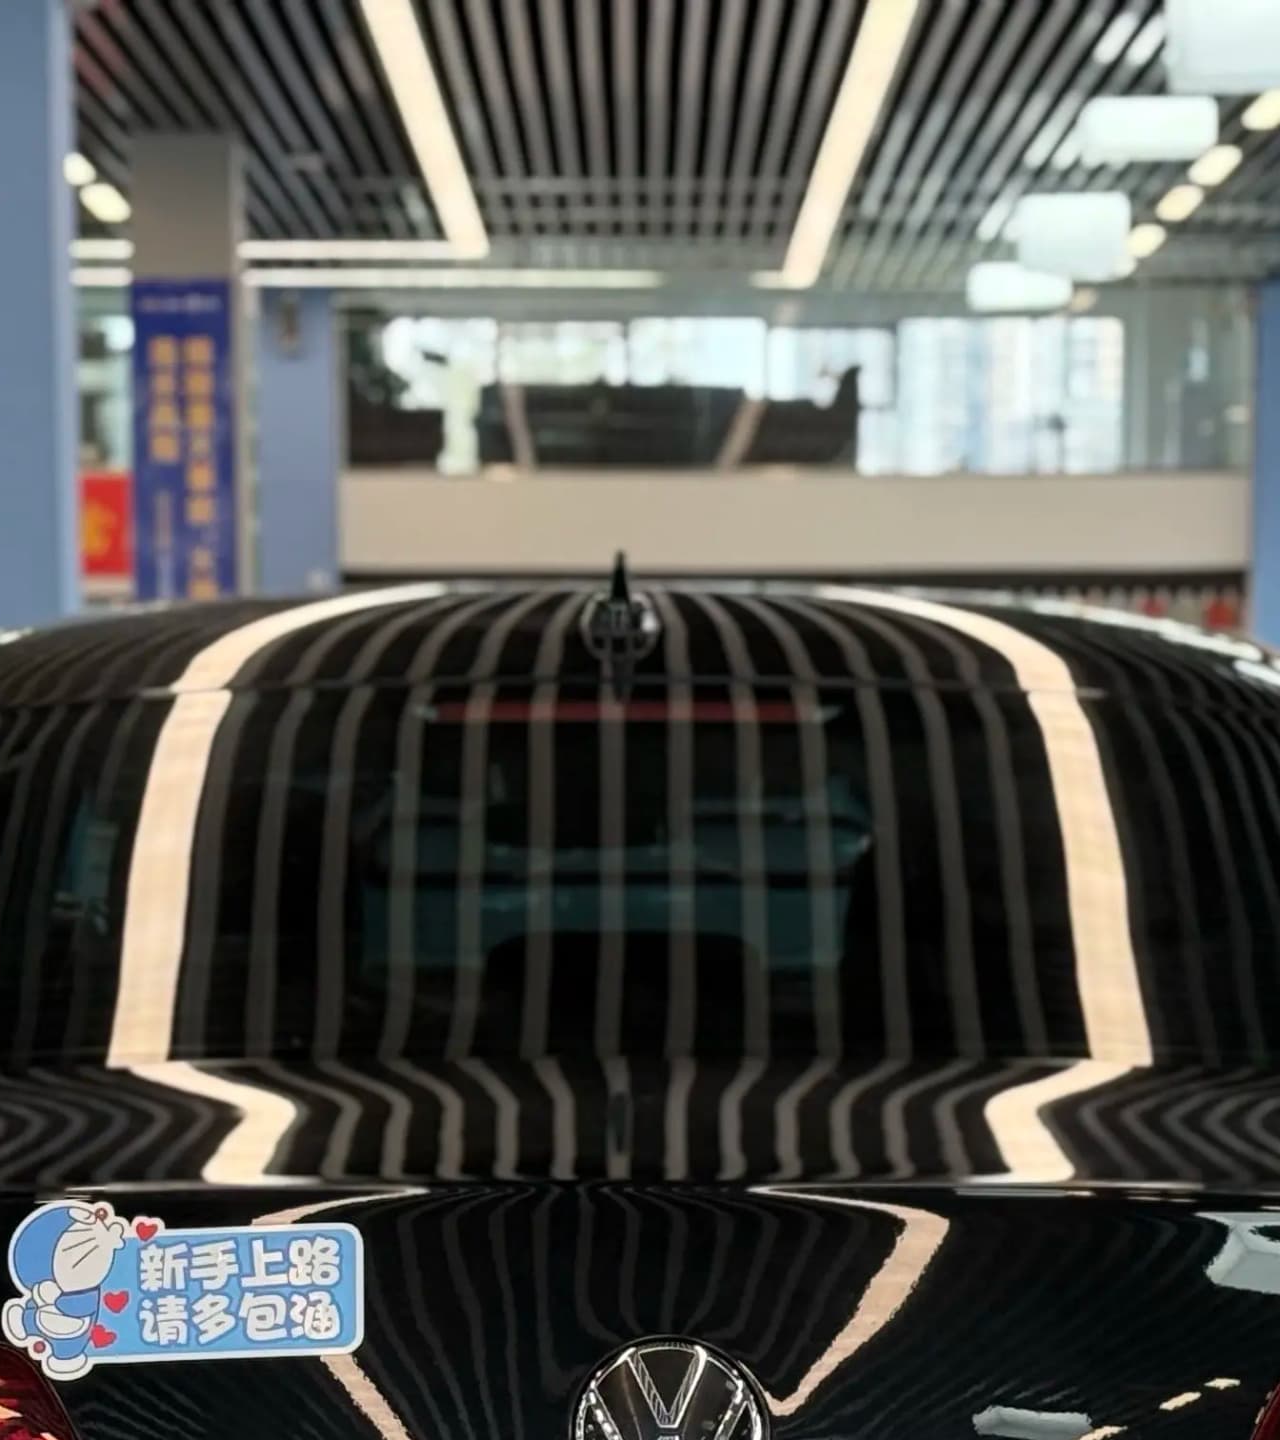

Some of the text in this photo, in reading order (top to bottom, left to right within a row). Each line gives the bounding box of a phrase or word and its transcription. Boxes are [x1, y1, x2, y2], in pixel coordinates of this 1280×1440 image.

[139, 1236, 342, 1293] 新手上路
[139, 1290, 342, 1347] 请多包涵
